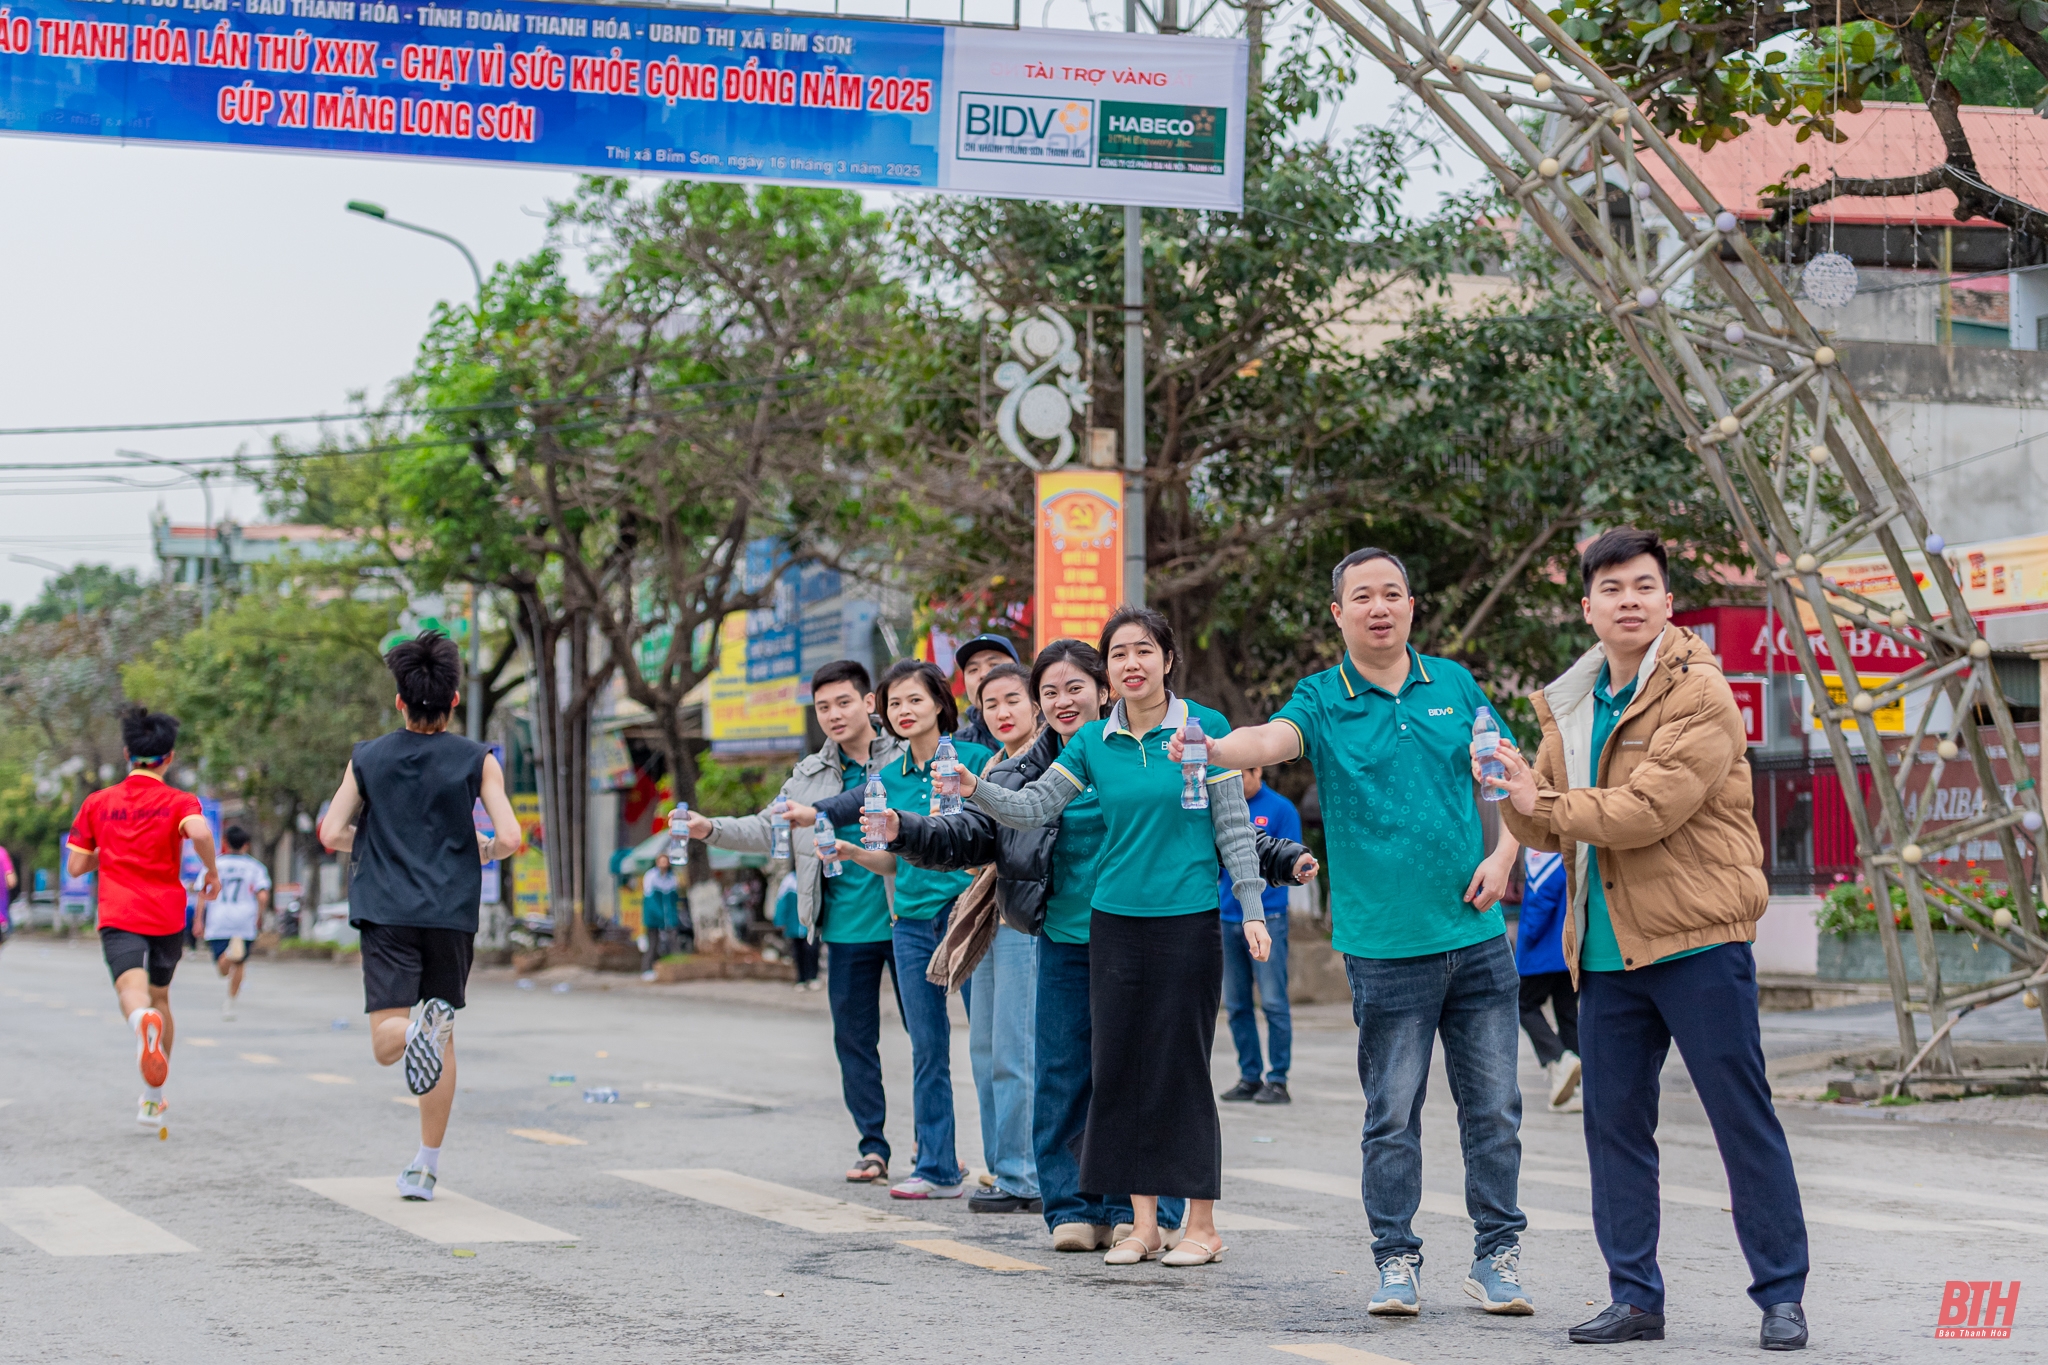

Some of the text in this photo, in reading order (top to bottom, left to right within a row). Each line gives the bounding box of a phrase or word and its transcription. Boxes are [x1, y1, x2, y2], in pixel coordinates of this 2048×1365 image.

[292, 0, 355, 20] THANH
[360, 1, 399, 23] HÓA
[418, 2, 462, 29] TỈNH
[466, 9, 520, 33] ĐOÀN
[525, 14, 587, 37] THANH
[592, 17, 631, 40] HÓA
[649, 23, 700, 45] UBND
[706, 27, 735, 51] THỊ
[740, 28, 766, 49] XÃ
[771, 27, 807, 52] BỈM
[812, 34, 853, 54] SƠN
[38, 19, 126, 60] THANH
[134, 19, 190, 65] HÓA
[197, 19, 248, 68] LẦN
[257, 29, 311, 72] THỨ
[313, 38, 378, 77] XXIX
[402, 44, 473, 90] CHẠY
[479, 43, 504, 86] VÌ
[511, 46, 565, 90] SỨC
[571, 46, 640, 95] KHỎE
[646, 55, 718, 106] CỘNG
[802, 65, 863, 110] NĂM
[867, 76, 932, 114] 2025
[1024, 61, 1168, 87] TÀI TRỢ VÀNG
[218, 82, 534, 141] CÚP XI MĂNG LONG SƠN
[966, 103, 1058, 139] BIDV
[1108, 115, 1195, 136] HABECO
[605, 145, 630, 162] Thị
[634, 147, 652, 161] xã
[656, 147, 686, 163] Bỉm
[728, 154, 765, 171] ngày
[770, 156, 787, 170] 16
[790, 155, 834, 175] tháng
[837, 160, 847, 173] 3
[850, 161, 883, 175] năm
[886, 163, 922, 177] 2025
[1428, 708, 1447, 716] BIDV
